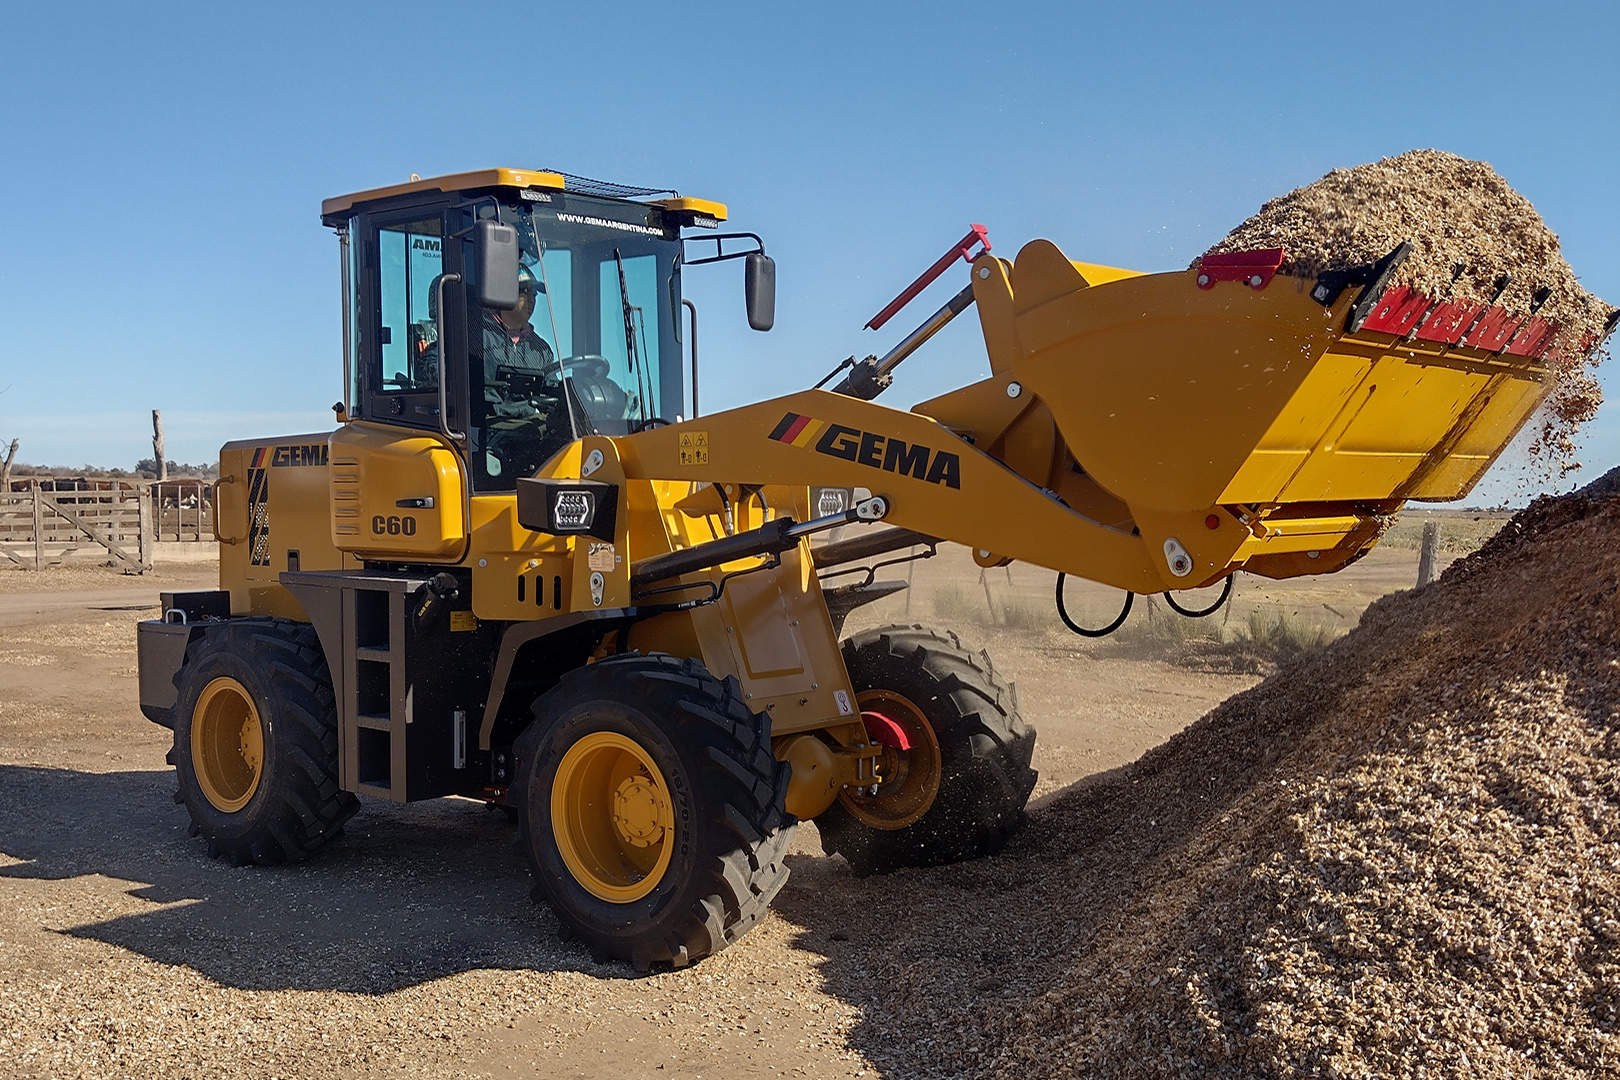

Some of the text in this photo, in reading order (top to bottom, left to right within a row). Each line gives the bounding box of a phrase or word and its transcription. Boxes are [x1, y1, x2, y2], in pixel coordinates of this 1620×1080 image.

[556, 212, 664, 237] WWW.GEMAARGENTINA.COM
[815, 424, 961, 490] GEMA
[372, 515, 416, 536] C60
